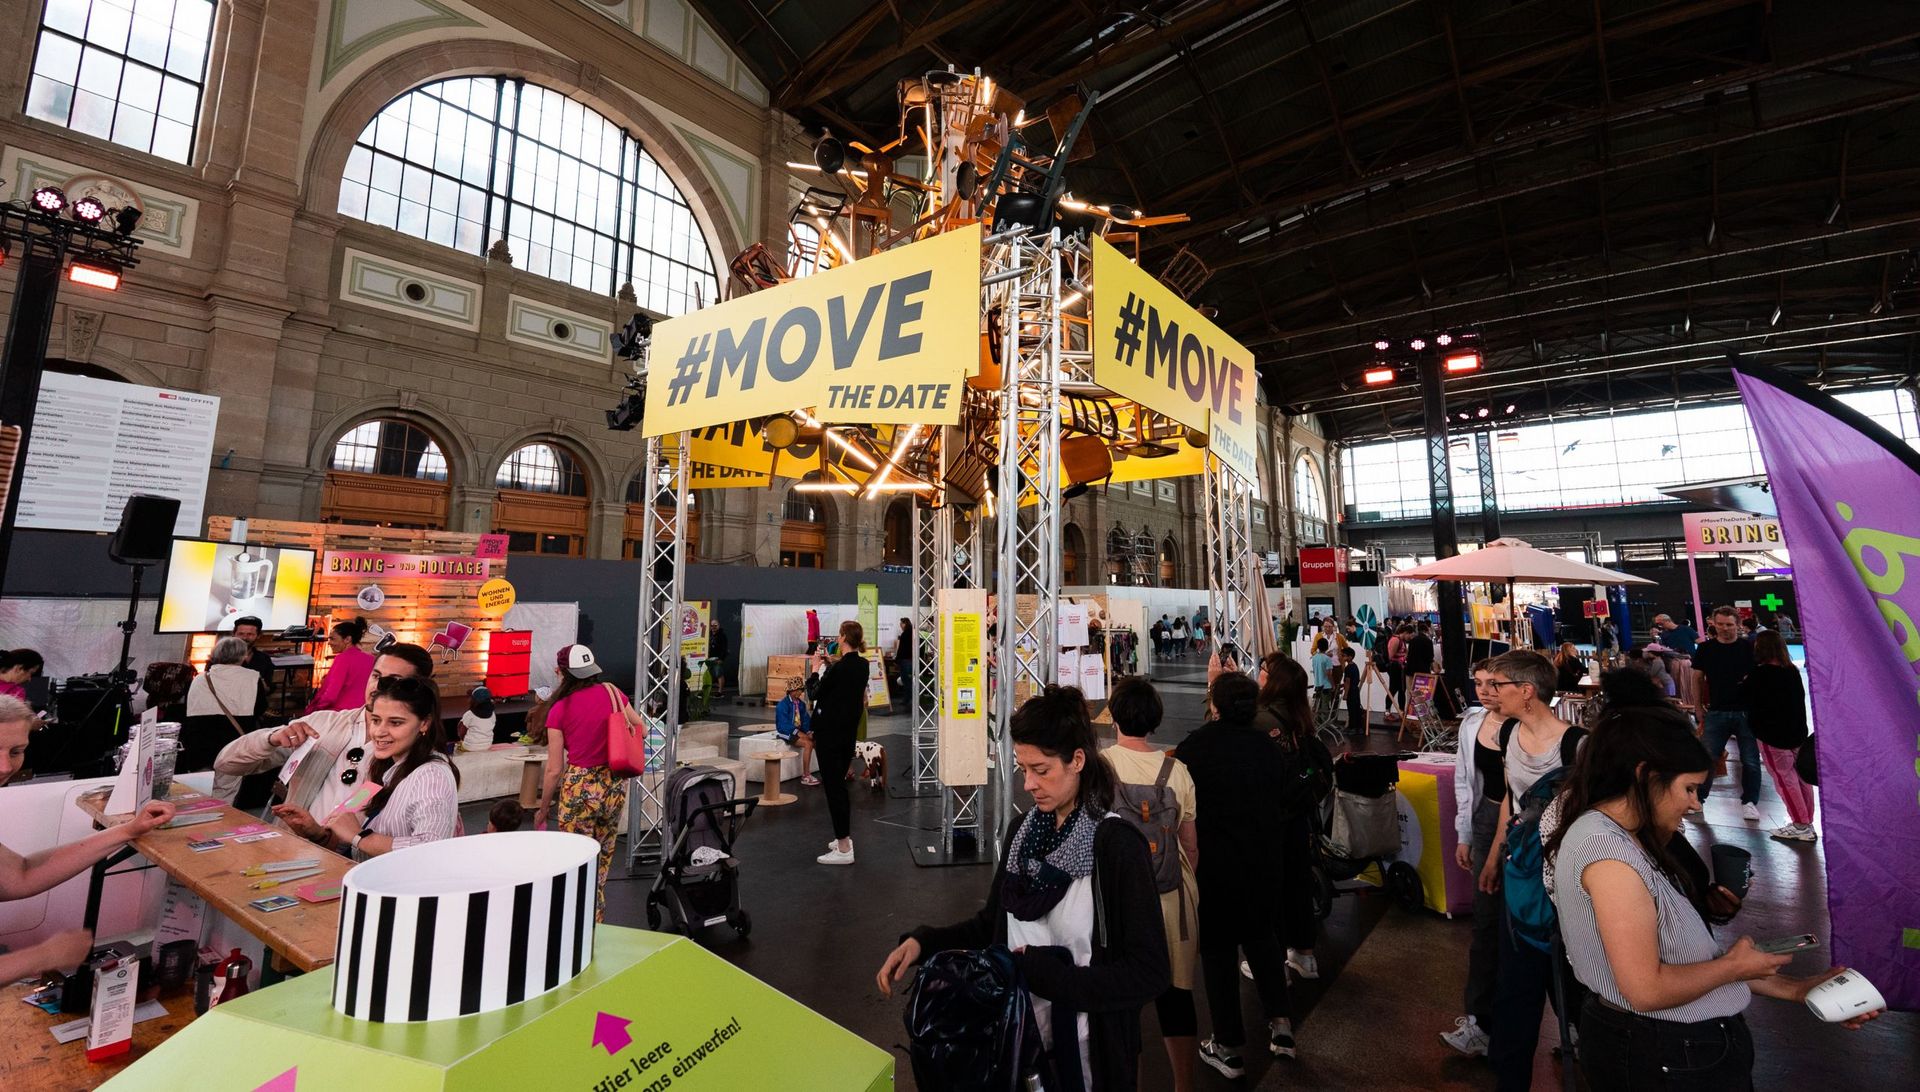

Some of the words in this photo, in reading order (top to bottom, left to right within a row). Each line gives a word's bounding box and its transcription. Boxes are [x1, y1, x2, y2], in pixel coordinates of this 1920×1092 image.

[666, 270, 932, 407] #MOVE
[1114, 291, 1243, 425] #MOVE
[828, 384, 876, 409] THE
[877, 383, 952, 410] DATE
[1213, 423, 1231, 454] THE
[1232, 443, 1254, 473] DATE
[690, 461, 715, 479] HE
[1701, 523, 1779, 545] BRING
[419, 560, 484, 576] HOLTAGE
[1302, 561, 1334, 570] Gruppen
[482, 586, 511, 598] WOHNEN
[485, 598, 510, 609] ENERGIE
[672, 1016, 742, 1078] einwerfen!
[593, 1067, 633, 1092] Hier
[630, 1041, 673, 1075] leere
